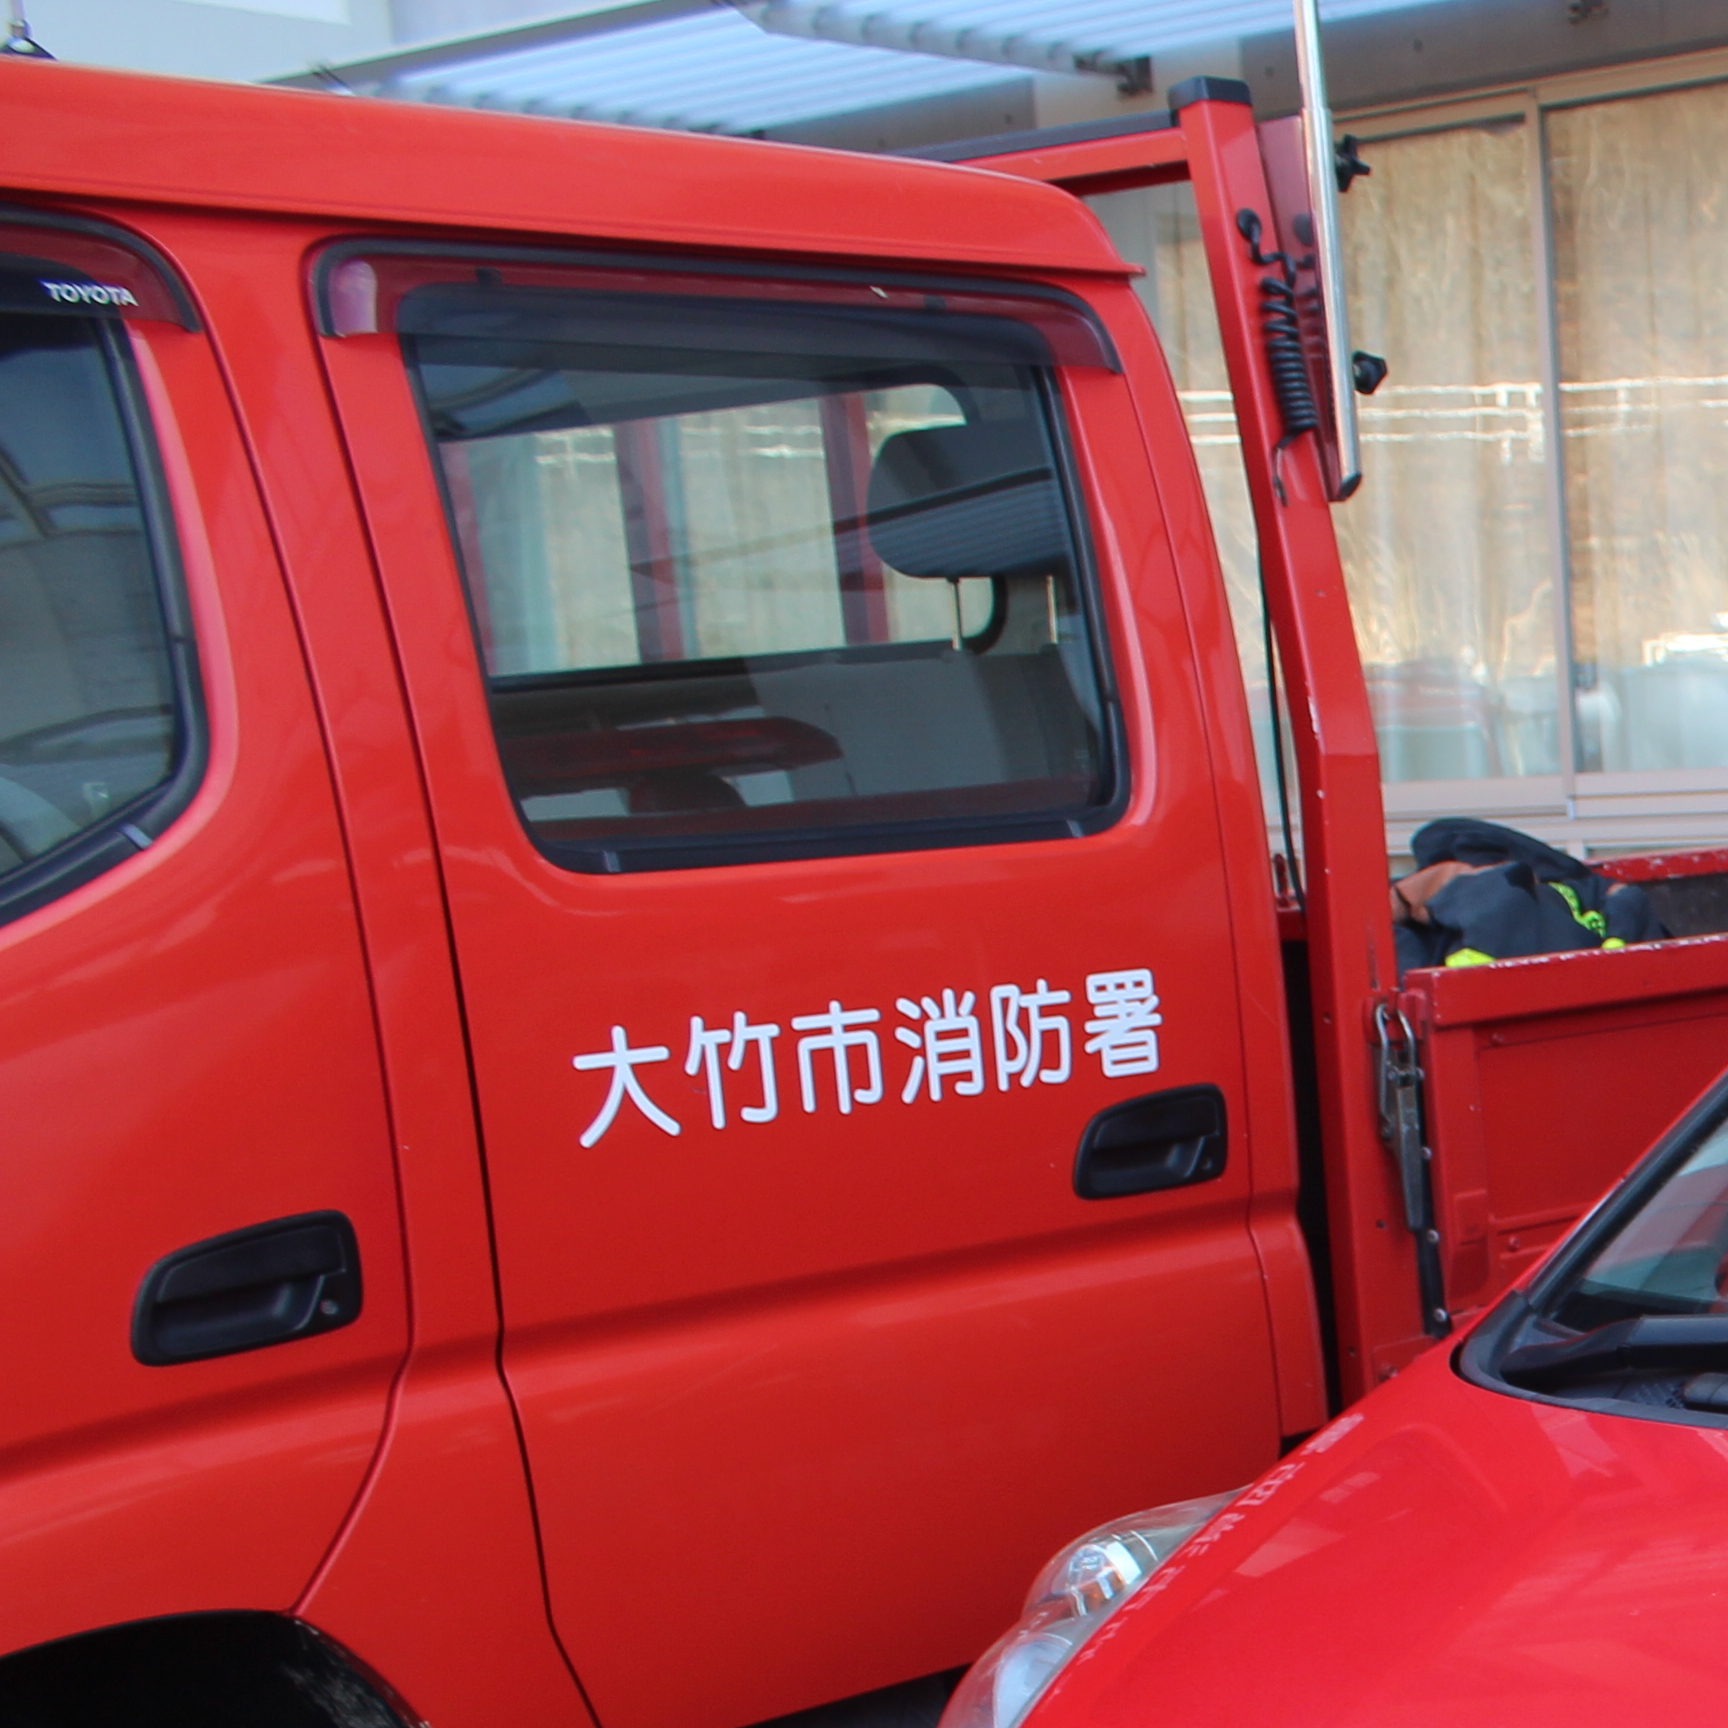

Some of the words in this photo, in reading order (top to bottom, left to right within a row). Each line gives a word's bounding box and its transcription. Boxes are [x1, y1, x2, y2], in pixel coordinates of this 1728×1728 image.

[39, 280, 139, 307] TOYOTA
[573, 968, 1162, 1148] 大竹市消防署
